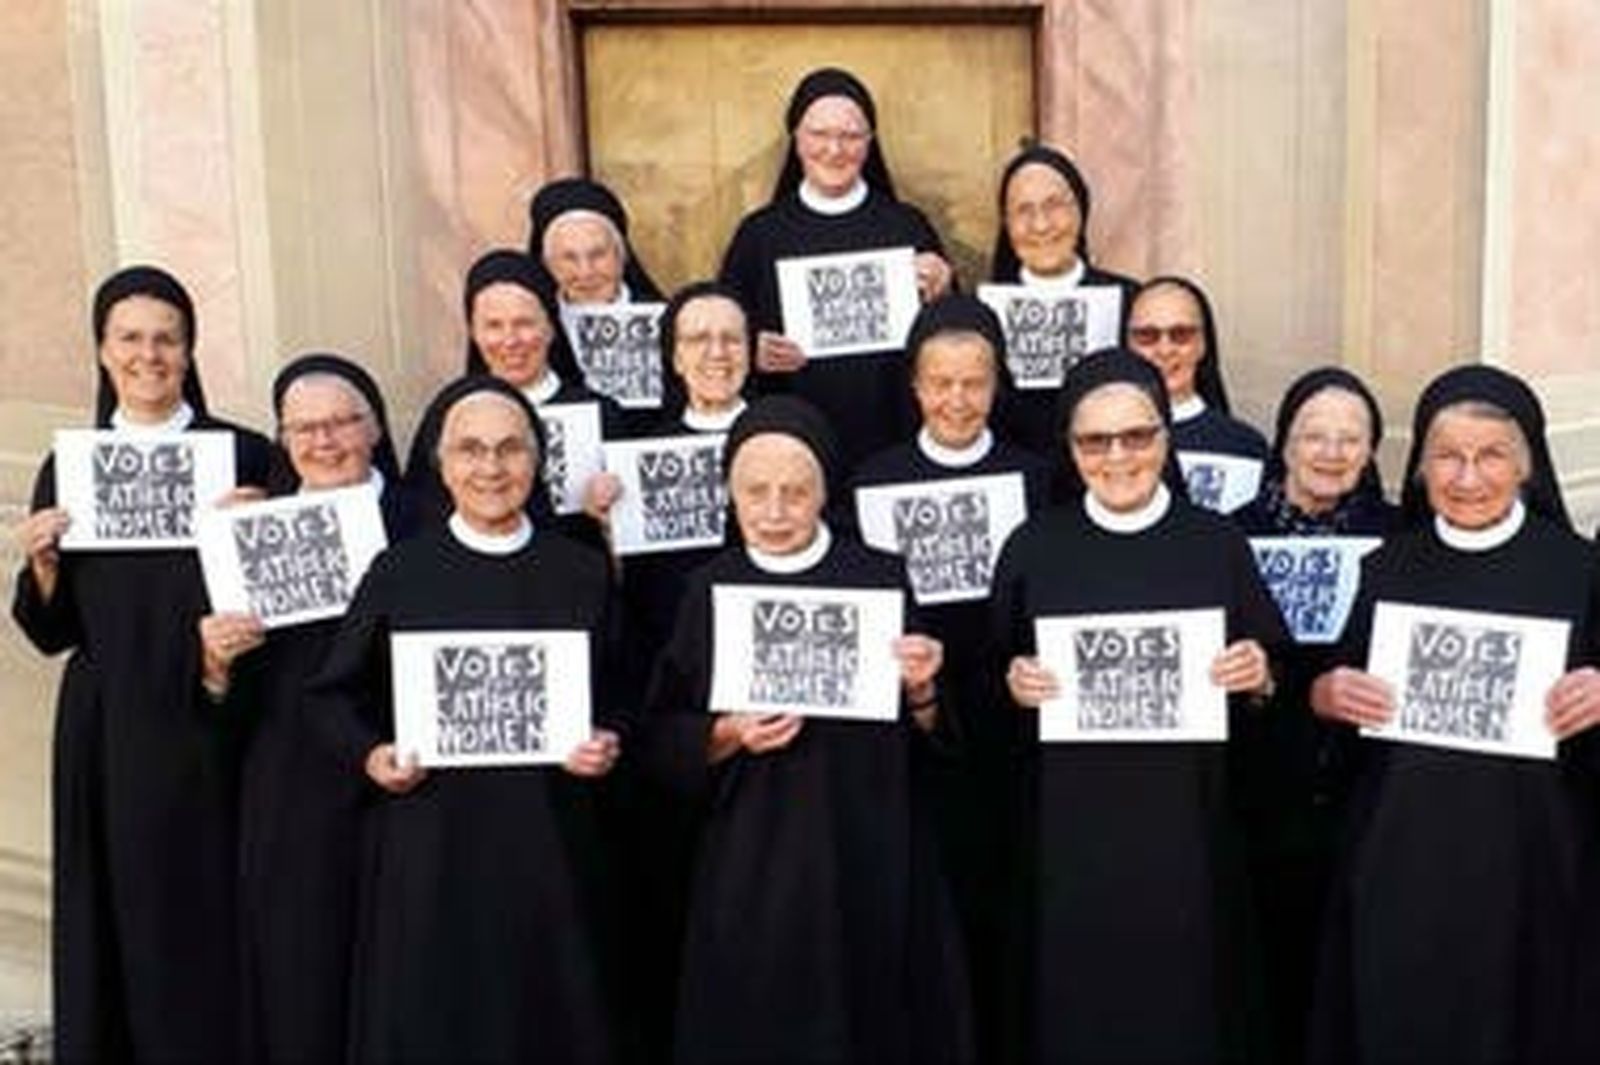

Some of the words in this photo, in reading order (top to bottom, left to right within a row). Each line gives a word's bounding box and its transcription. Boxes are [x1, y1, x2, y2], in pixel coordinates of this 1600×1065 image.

[94, 443, 193, 476] VOTES
[233, 503, 342, 550] VOTES
[896, 493, 986, 529] VOTES
[1254, 549, 1339, 575] VOTES
[755, 602, 857, 633] VOTES
[1074, 628, 1180, 661] VOTES
[1411, 623, 1521, 664] VOTES
[436, 646, 545, 681] VOTES
